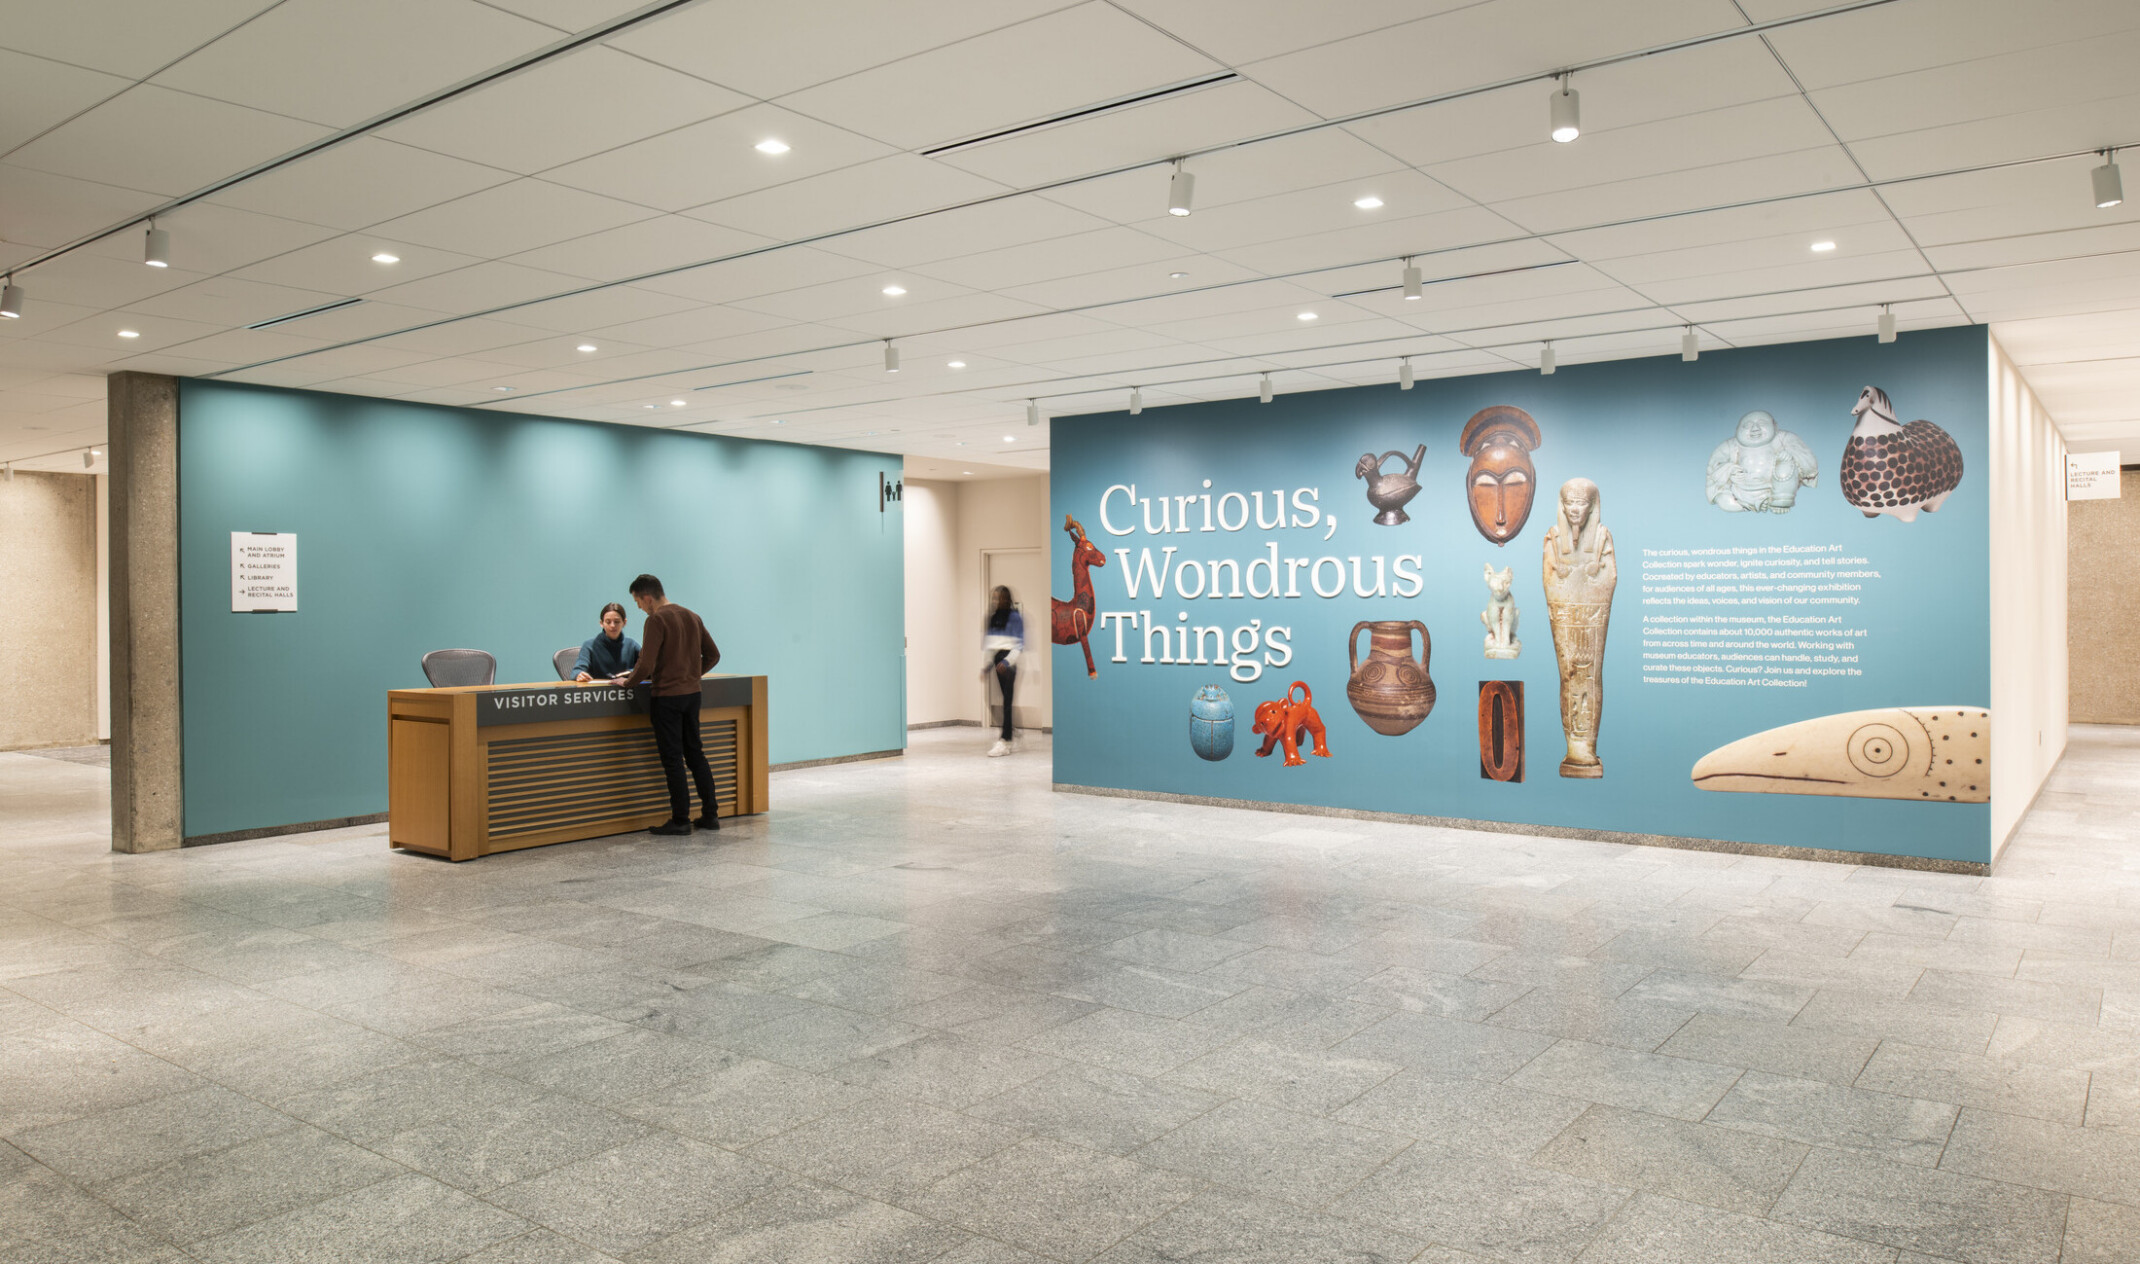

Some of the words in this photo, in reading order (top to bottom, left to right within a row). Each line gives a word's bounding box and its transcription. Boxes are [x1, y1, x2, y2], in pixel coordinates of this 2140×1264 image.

[1100, 479, 1337, 541] Curious,
[1732, 547, 1757, 555] things
[1768, 545, 1782, 553] the
[1783, 544, 1826, 553] Education
[1684, 560, 1705, 569] spark
[1707, 560, 1739, 568] wonder,
[1740, 559, 1763, 568] ignite
[1765, 558, 1802, 567] curiosity,
[1822, 557, 1836, 565] tell
[1114, 541, 1423, 599] Wondrous
[1643, 573, 1684, 581] Cocreated
[1686, 573, 1695, 581] by
[1740, 572, 1768, 580] artists,
[1770, 571, 1786, 579] and
[1787, 571, 1835, 579] community
[1716, 585, 1738, 593] ages,
[1740, 584, 1754, 592] this
[1756, 584, 1816, 592] ever-changing
[1643, 597, 1671, 605] reflects
[1687, 597, 1710, 605] ideas,
[1712, 597, 1740, 605] voices,
[1741, 596, 1756, 604] and
[1758, 596, 1782, 604] vision
[1784, 596, 1792, 604] of
[1810, 596, 1860, 605] community.
[1643, 627, 1682, 635] Collection
[1744, 628, 1773, 636] 10,000
[1844, 628, 1853, 636] of
[1855, 629, 1867, 637] art
[1101, 610, 1293, 682] Things
[1643, 639, 1660, 647] from
[1771, 641, 1796, 649] world.
[1798, 642, 1834, 650] Working
[1677, 652, 1720, 660] educators,
[1721, 653, 1763, 661] audiences
[1782, 654, 1812, 662] handle,
[1814, 655, 1840, 663] study,
[1842, 655, 1858, 663] and
[1693, 665, 1724, 673] objects.
[1726, 665, 1762, 673] Curious?
[1764, 666, 1782, 674] Join
[1795, 667, 1811, 675] and
[1813, 668, 1846, 676] explore
[1848, 668, 1862, 676] the
[1705, 677, 1746, 685] Education
[1748, 678, 1760, 686] Art
[1762, 679, 1807, 687] Collection!
[494, 694, 557, 709] VISITOR
[564, 689, 634, 704] SERVICES
